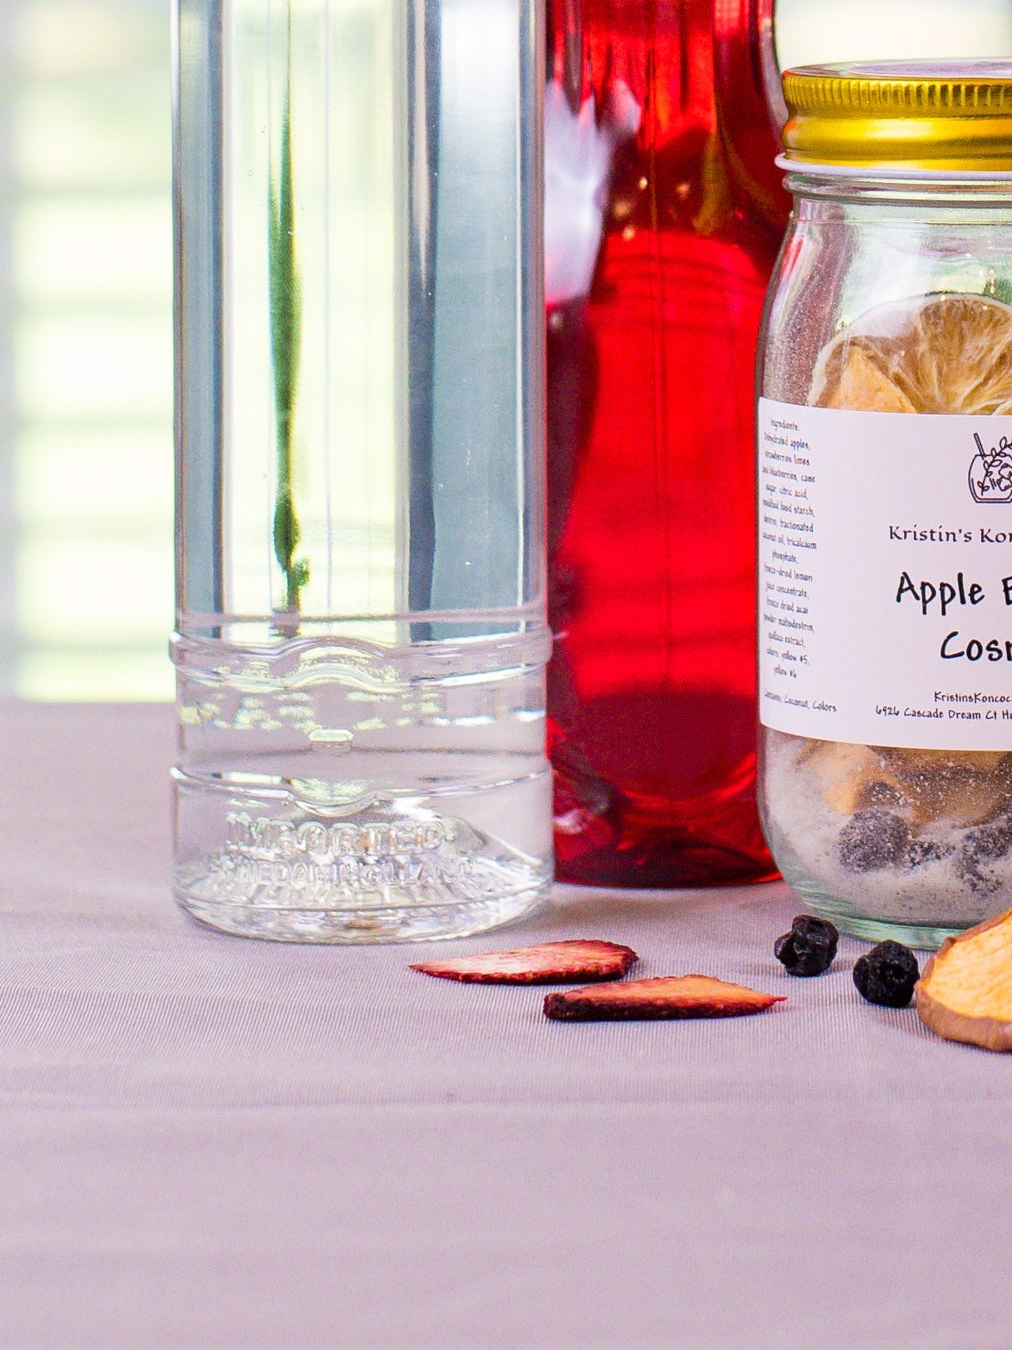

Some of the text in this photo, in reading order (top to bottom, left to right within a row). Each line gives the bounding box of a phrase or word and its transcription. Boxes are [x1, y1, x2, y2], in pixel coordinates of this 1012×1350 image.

[794, 505, 815, 518] starch,
[889, 524, 973, 543] Kristin's
[793, 570, 812, 581] lemon
[896, 571, 986, 616] Apple
[812, 700, 837, 712] Colors
[875, 705, 900, 717] 6926
[904, 707, 944, 719] Cascade
[948, 709, 981, 720] Dream
[985, 710, 997, 720] Ct
